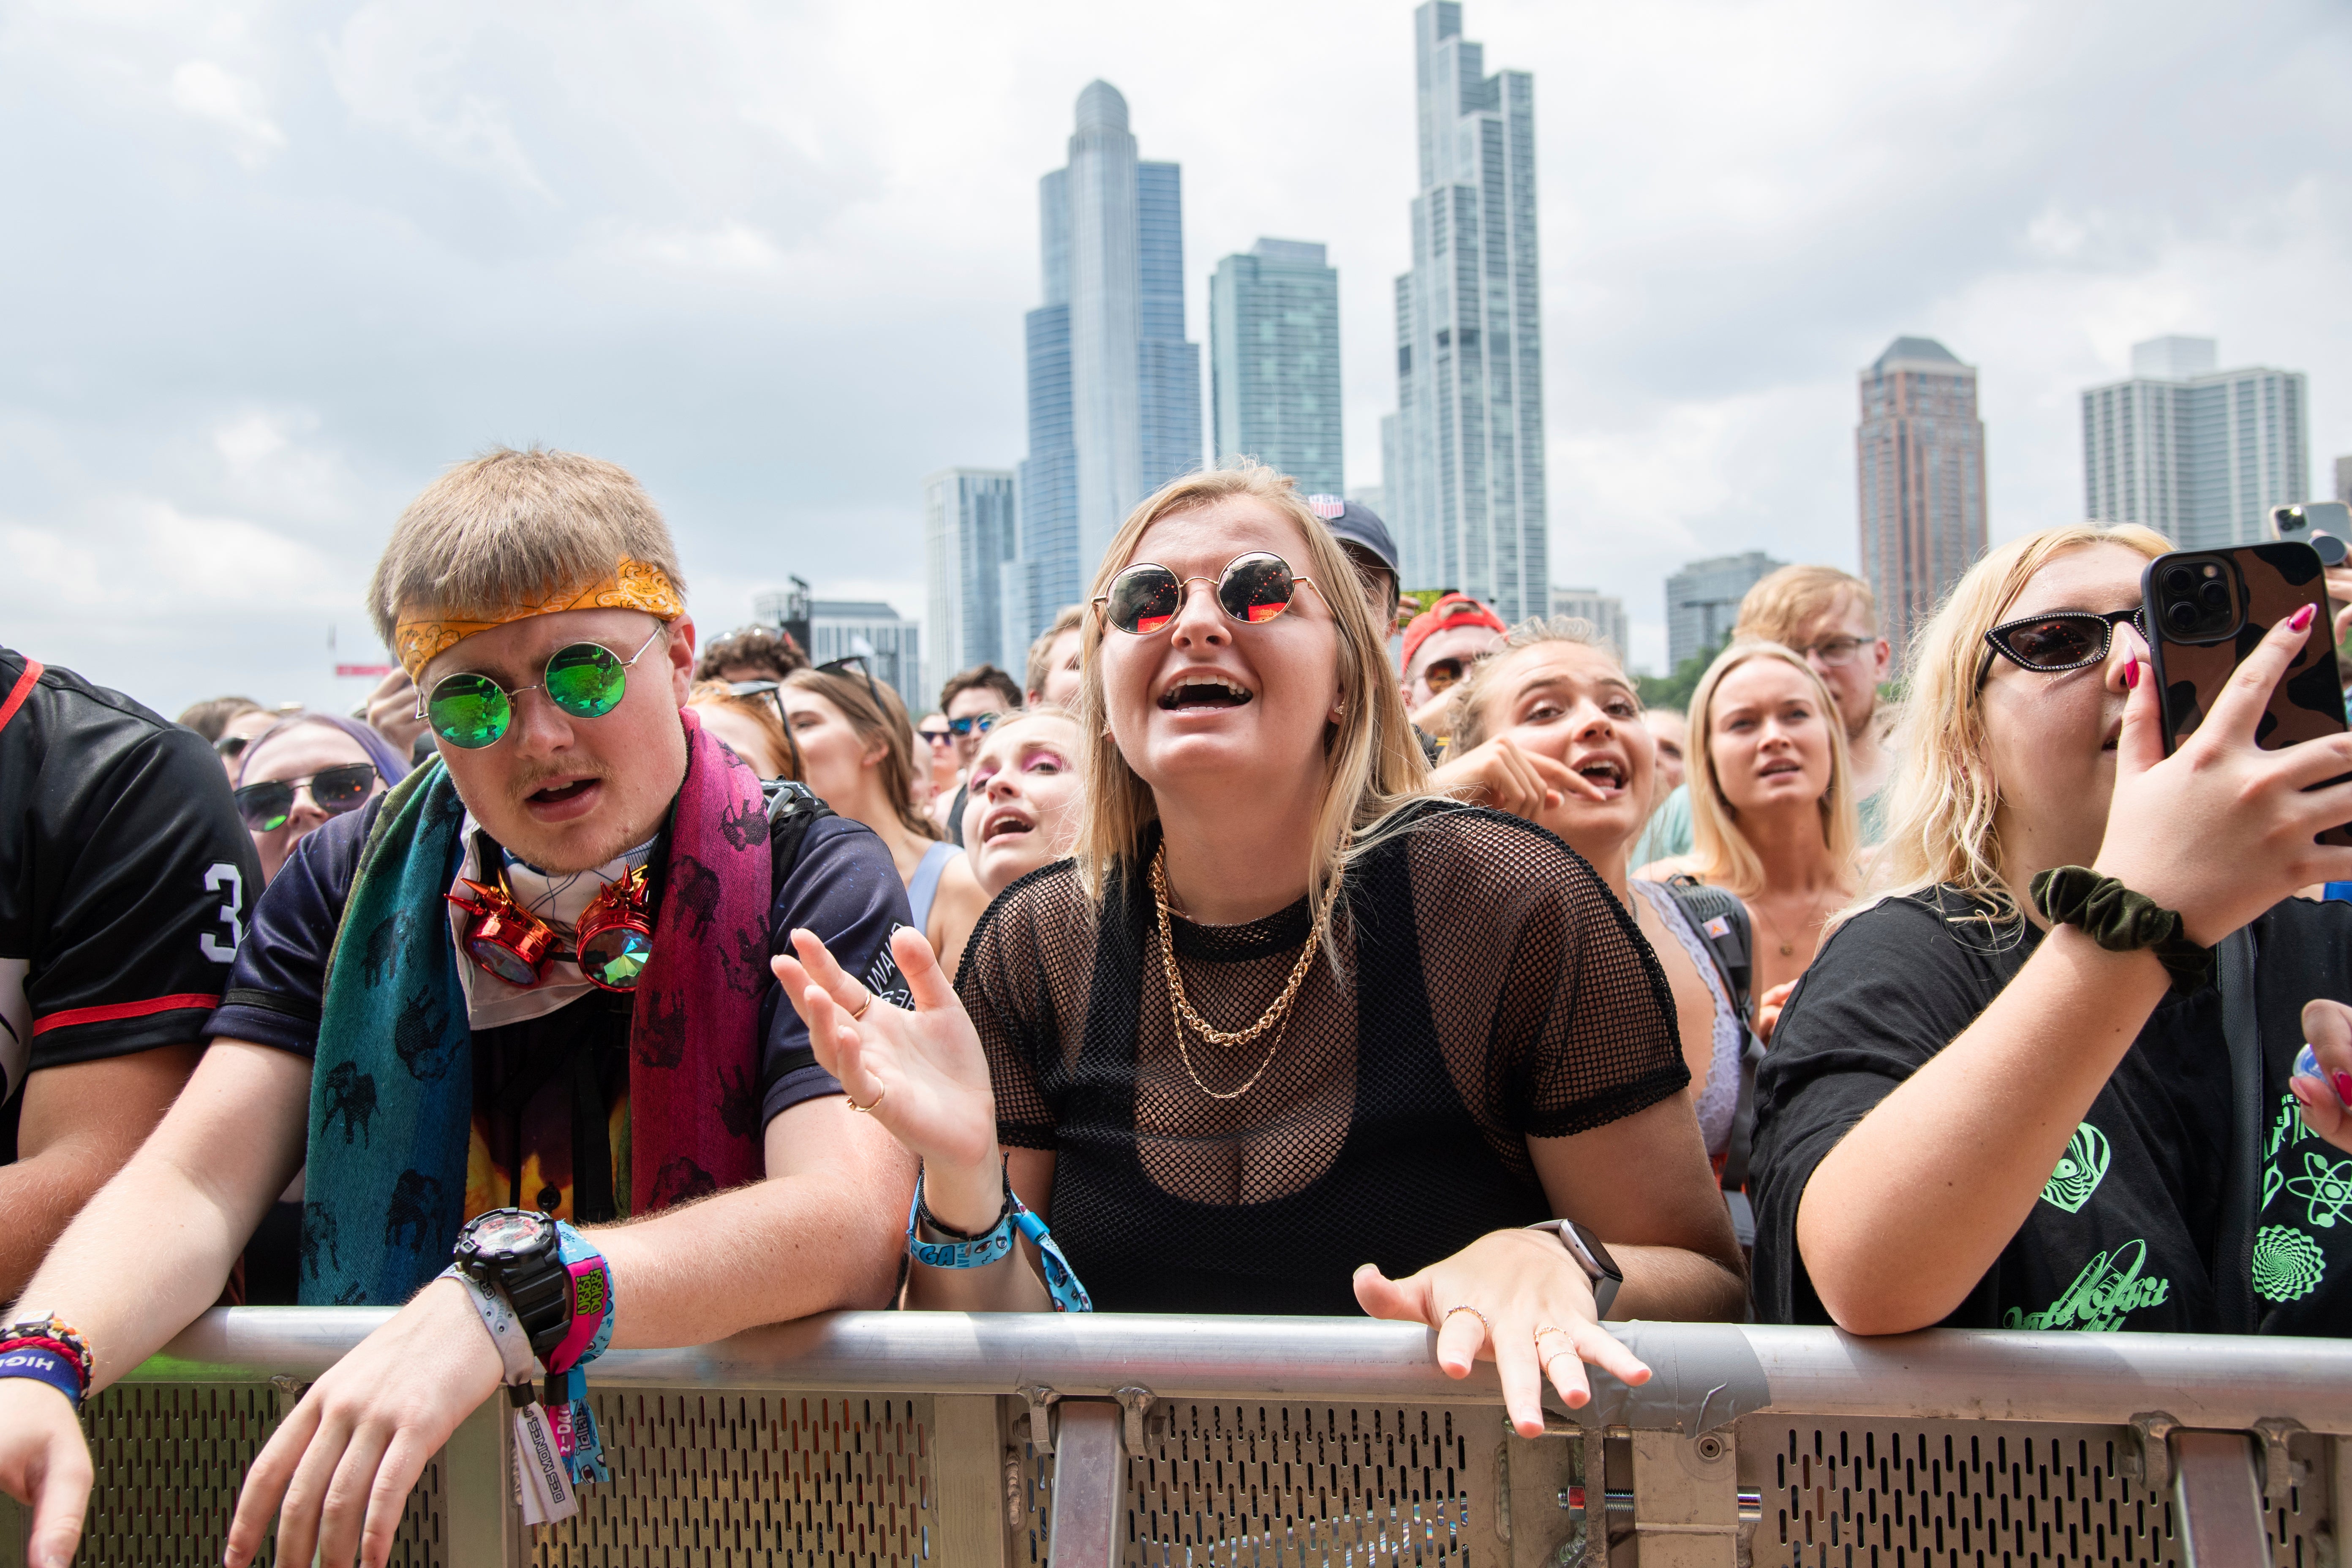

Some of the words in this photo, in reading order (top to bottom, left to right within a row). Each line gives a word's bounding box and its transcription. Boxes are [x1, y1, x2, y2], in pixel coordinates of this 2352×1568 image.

[200, 863, 242, 963] 3
[919, 1245, 956, 1266] GA
[546, 1471, 566, 1504] DES
